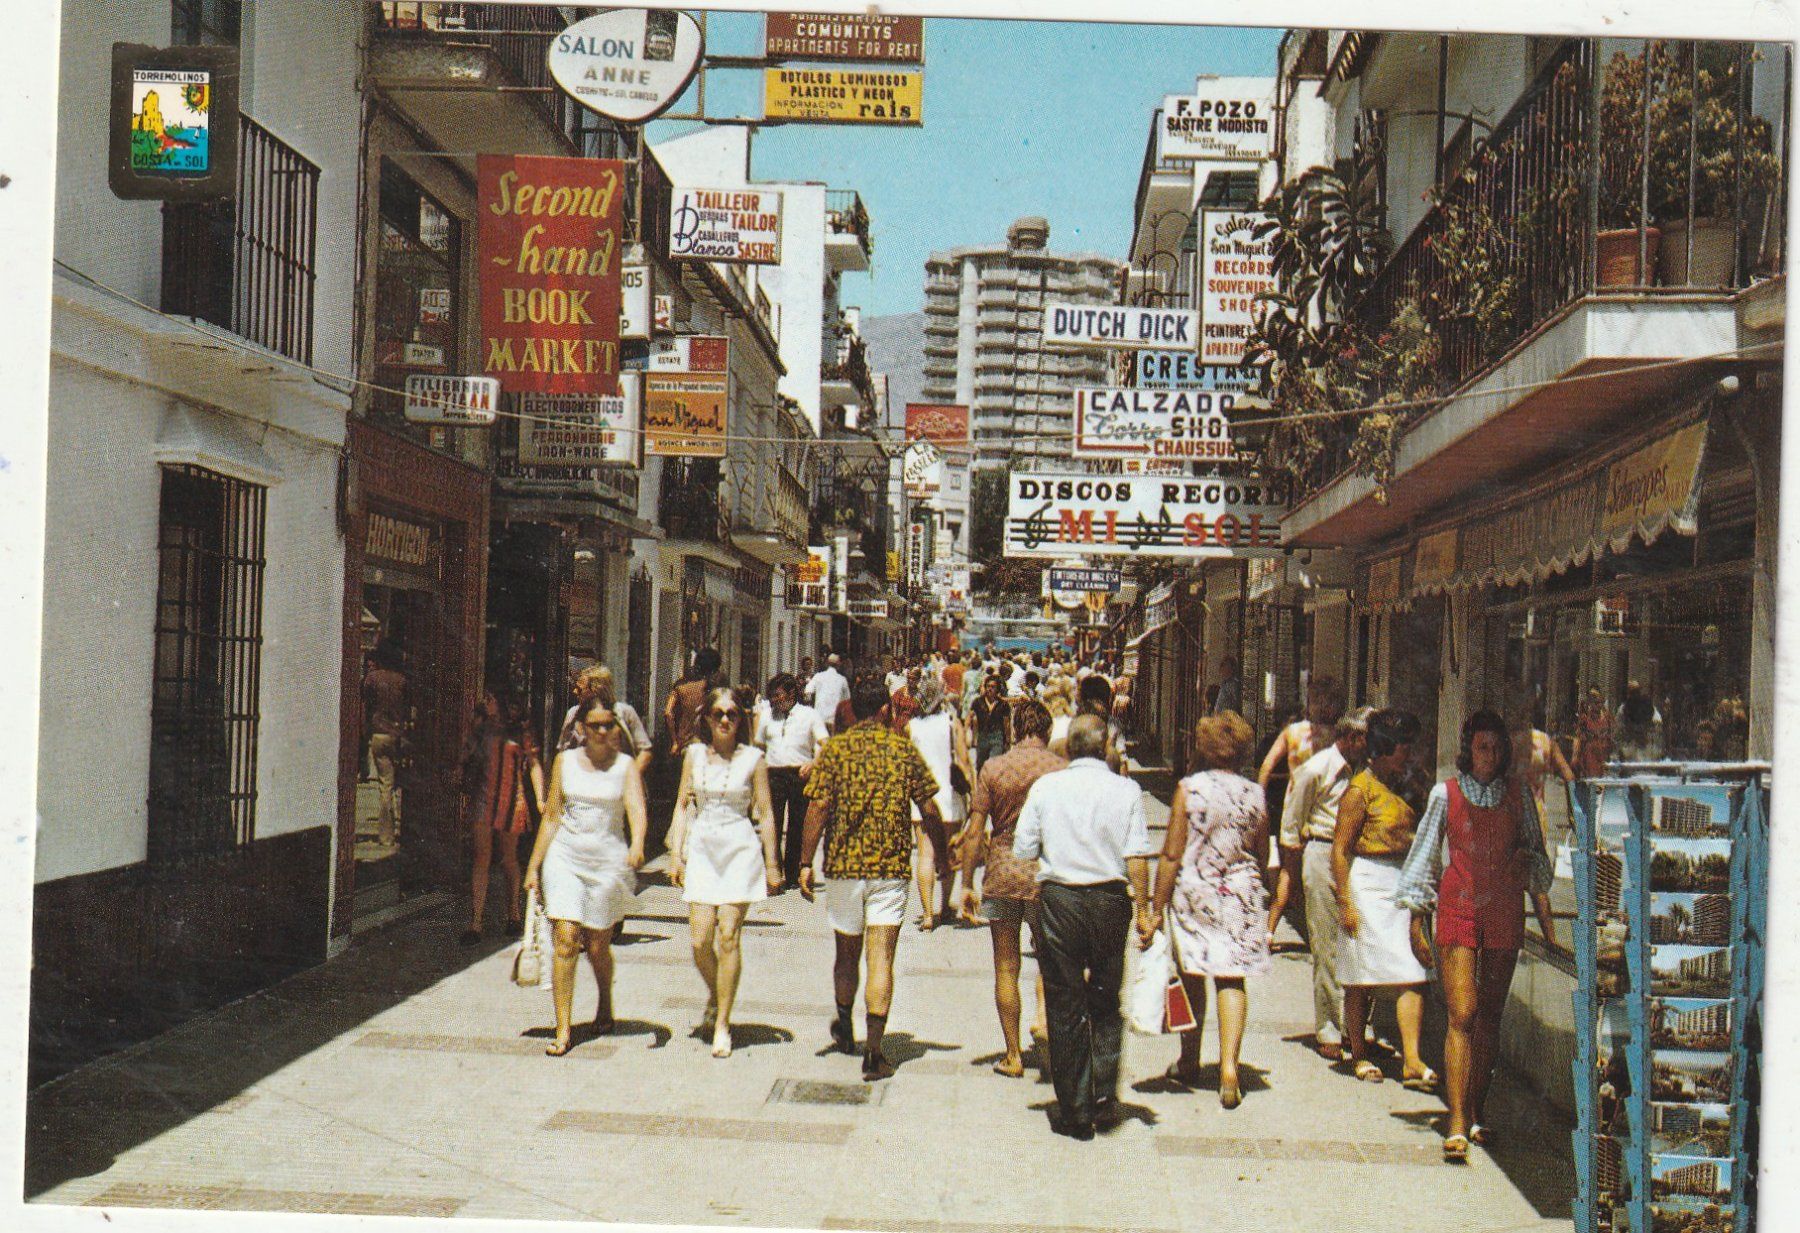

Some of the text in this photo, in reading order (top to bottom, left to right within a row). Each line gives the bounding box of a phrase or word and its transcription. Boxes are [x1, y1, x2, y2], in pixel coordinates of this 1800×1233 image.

[797, 23, 892, 40] COMUNITYS
[558, 34, 634, 59] SALON
[768, 38, 918, 57] APARTMENTS FOR RENT
[134, 72, 205, 82] TORREMOLINOS
[584, 66, 651, 86] ANNE
[781, 71, 908, 87] ROTULOS LUMINOSOS
[790, 86, 894, 101] PLASTICO Y NEON
[859, 100, 912, 118] rais
[1177, 99, 1256, 119] F. POZO
[1167, 117, 1268, 134] SASTRE MODISTO
[133, 154, 174, 166] COSTA
[185, 156, 205, 167] SOL
[490, 169, 617, 218] Second
[695, 191, 760, 212] TAILLEUR
[672, 194, 735, 255] Blanco
[731, 213, 778, 232] TAILOR
[737, 242, 776, 260] SASTRE
[1214, 259, 1274, 276] RECORDS
[1208, 279, 1275, 294] SOUVENIRS
[502, 288, 595, 325] BOOK
[1219, 298, 1269, 313] SHOES
[1055, 308, 1189, 343] DUTCH DICK
[485, 337, 617, 374] MARKET
[525, 401, 624, 414] ELECTRODOMESTICOS
[532, 430, 616, 445] FERRONNERIE
[538, 446, 608, 459] IRON-WARE
[1019, 480, 1287, 504] DISCOS RECORD
[1057, 508, 1276, 549] MI SOL
